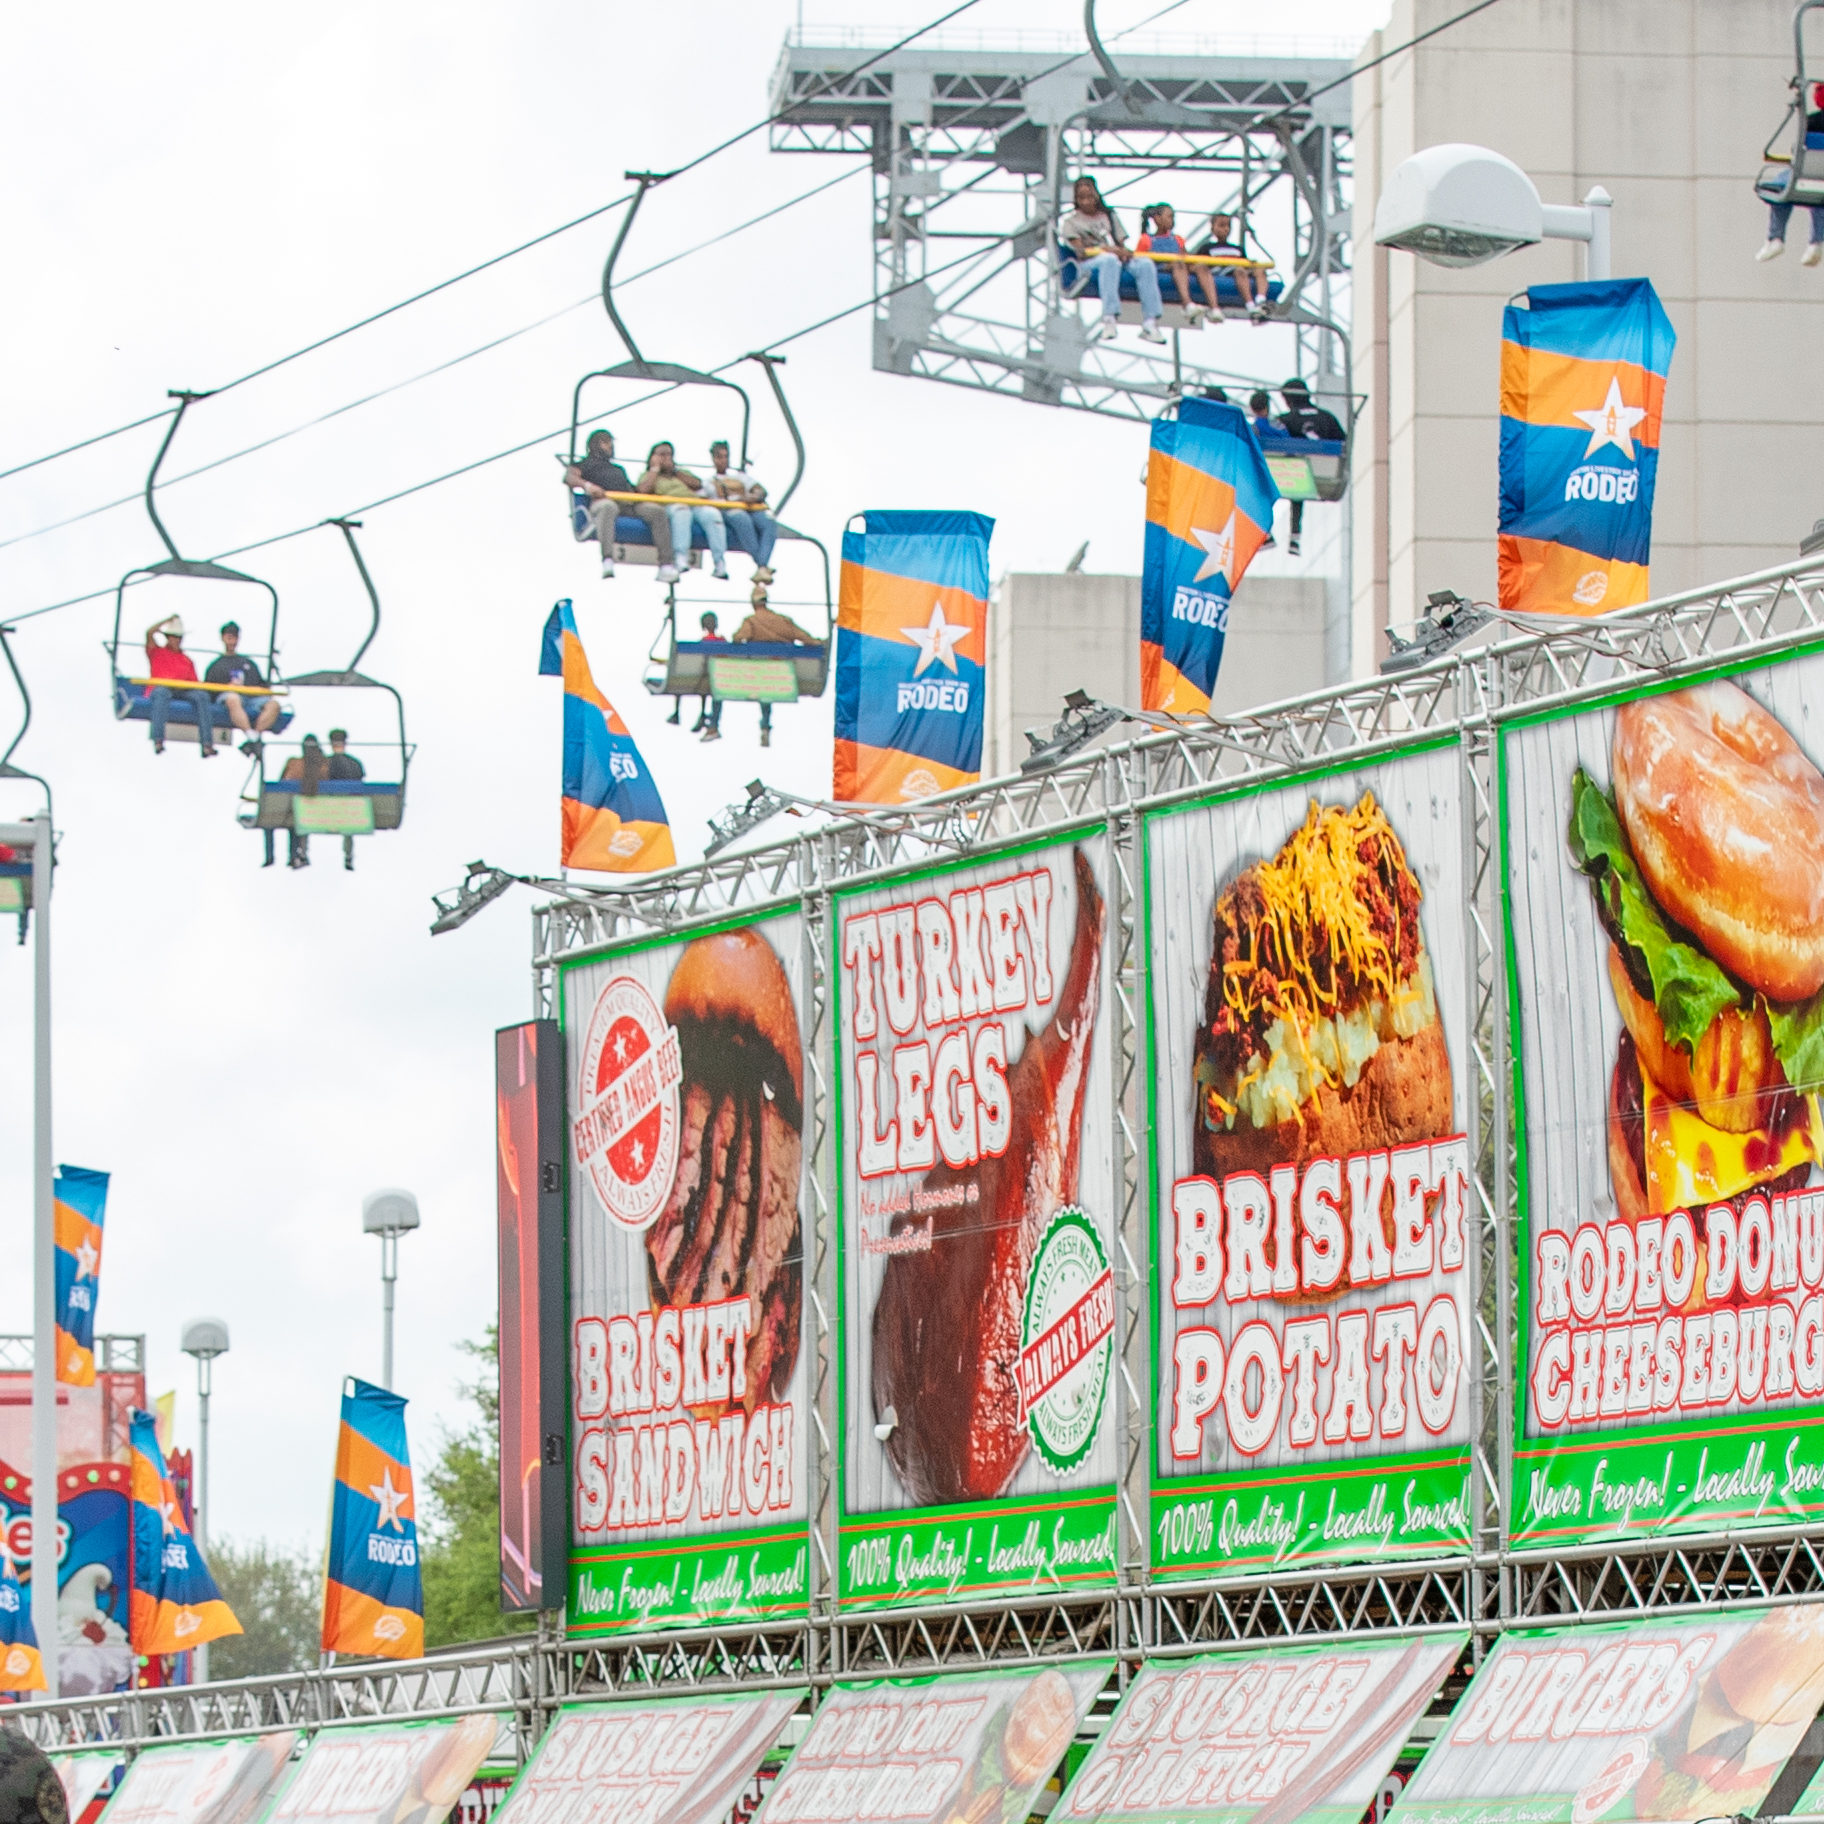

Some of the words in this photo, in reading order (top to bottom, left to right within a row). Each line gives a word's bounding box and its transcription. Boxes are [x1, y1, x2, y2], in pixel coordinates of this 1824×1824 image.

[1565, 472, 1638, 504] RODEO
[897, 685, 969, 714] RODEO
[845, 867, 1054, 1042] TURKEY
[656, 1035, 680, 1090] BEEF
[856, 1022, 1013, 1180] LEGS
[1052, 1235, 1078, 1260] FRESH
[1173, 1133, 1469, 1309] BRISKET
[1538, 1211, 1698, 1327] RODEO
[577, 1294, 753, 1420] BRISKET
[1025, 1315, 1079, 1401] ALWAYS
[1078, 1277, 1114, 1350] FRESH
[1171, 1294, 1460, 1459] POTATO
[577, 1403, 793, 1531] SANDWICH
[1067, 1405, 1093, 1446] FRESH
[1158, 1498, 1214, 1561] 100%
[1218, 1489, 1306, 1564] Quality!
[1323, 1481, 1395, 1555] Locally
[1399, 1472, 1472, 1537] Sourced!
[1523, 1463, 1582, 1524] Never
[1587, 1448, 1675, 1535] Frozen!
[1693, 1440, 1775, 1520] Locally
[367, 1538, 416, 1567] RODEO
[575, 1569, 615, 1617] Never
[617, 1561, 680, 1627] Frozen!
[691, 1558, 745, 1617] Locally
[745, 1545, 806, 1600] Sourced!
[847, 1534, 892, 1593] 100%
[895, 1526, 973, 1595] Quality!
[987, 1518, 1047, 1587] Locally
[1049, 1510, 1117, 1569] Sourced!
[1108, 1657, 1371, 1750] SAUSAGE
[1450, 1632, 1718, 1747] BURGERS
[531, 1708, 736, 1784] SAUSAGE
[1159, 1739, 1312, 1806] STICK
